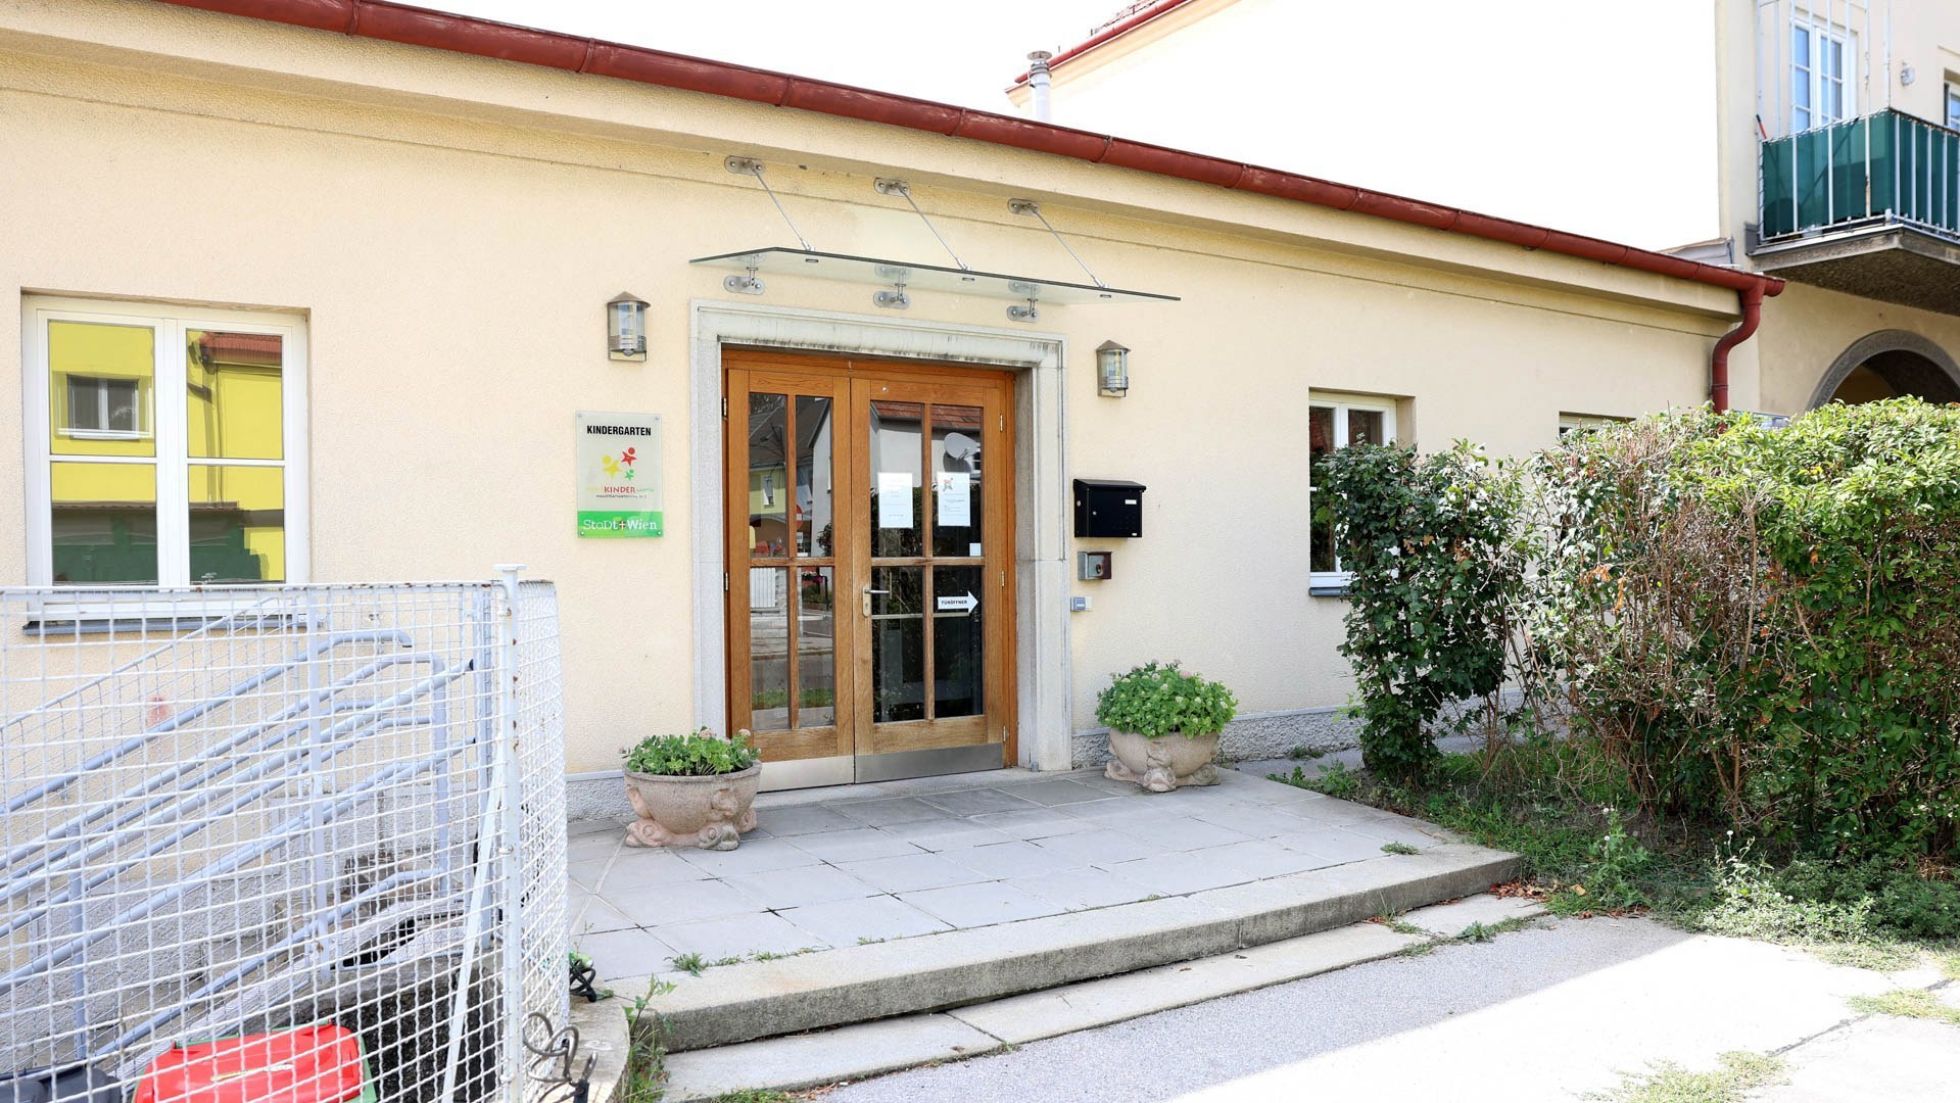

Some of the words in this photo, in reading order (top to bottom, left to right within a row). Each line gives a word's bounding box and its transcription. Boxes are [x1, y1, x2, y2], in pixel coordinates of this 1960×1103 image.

[586, 425, 652, 436] KINDERGARTEN
[603, 486, 636, 494] KINDER
[626, 518, 658, 531] Wien
